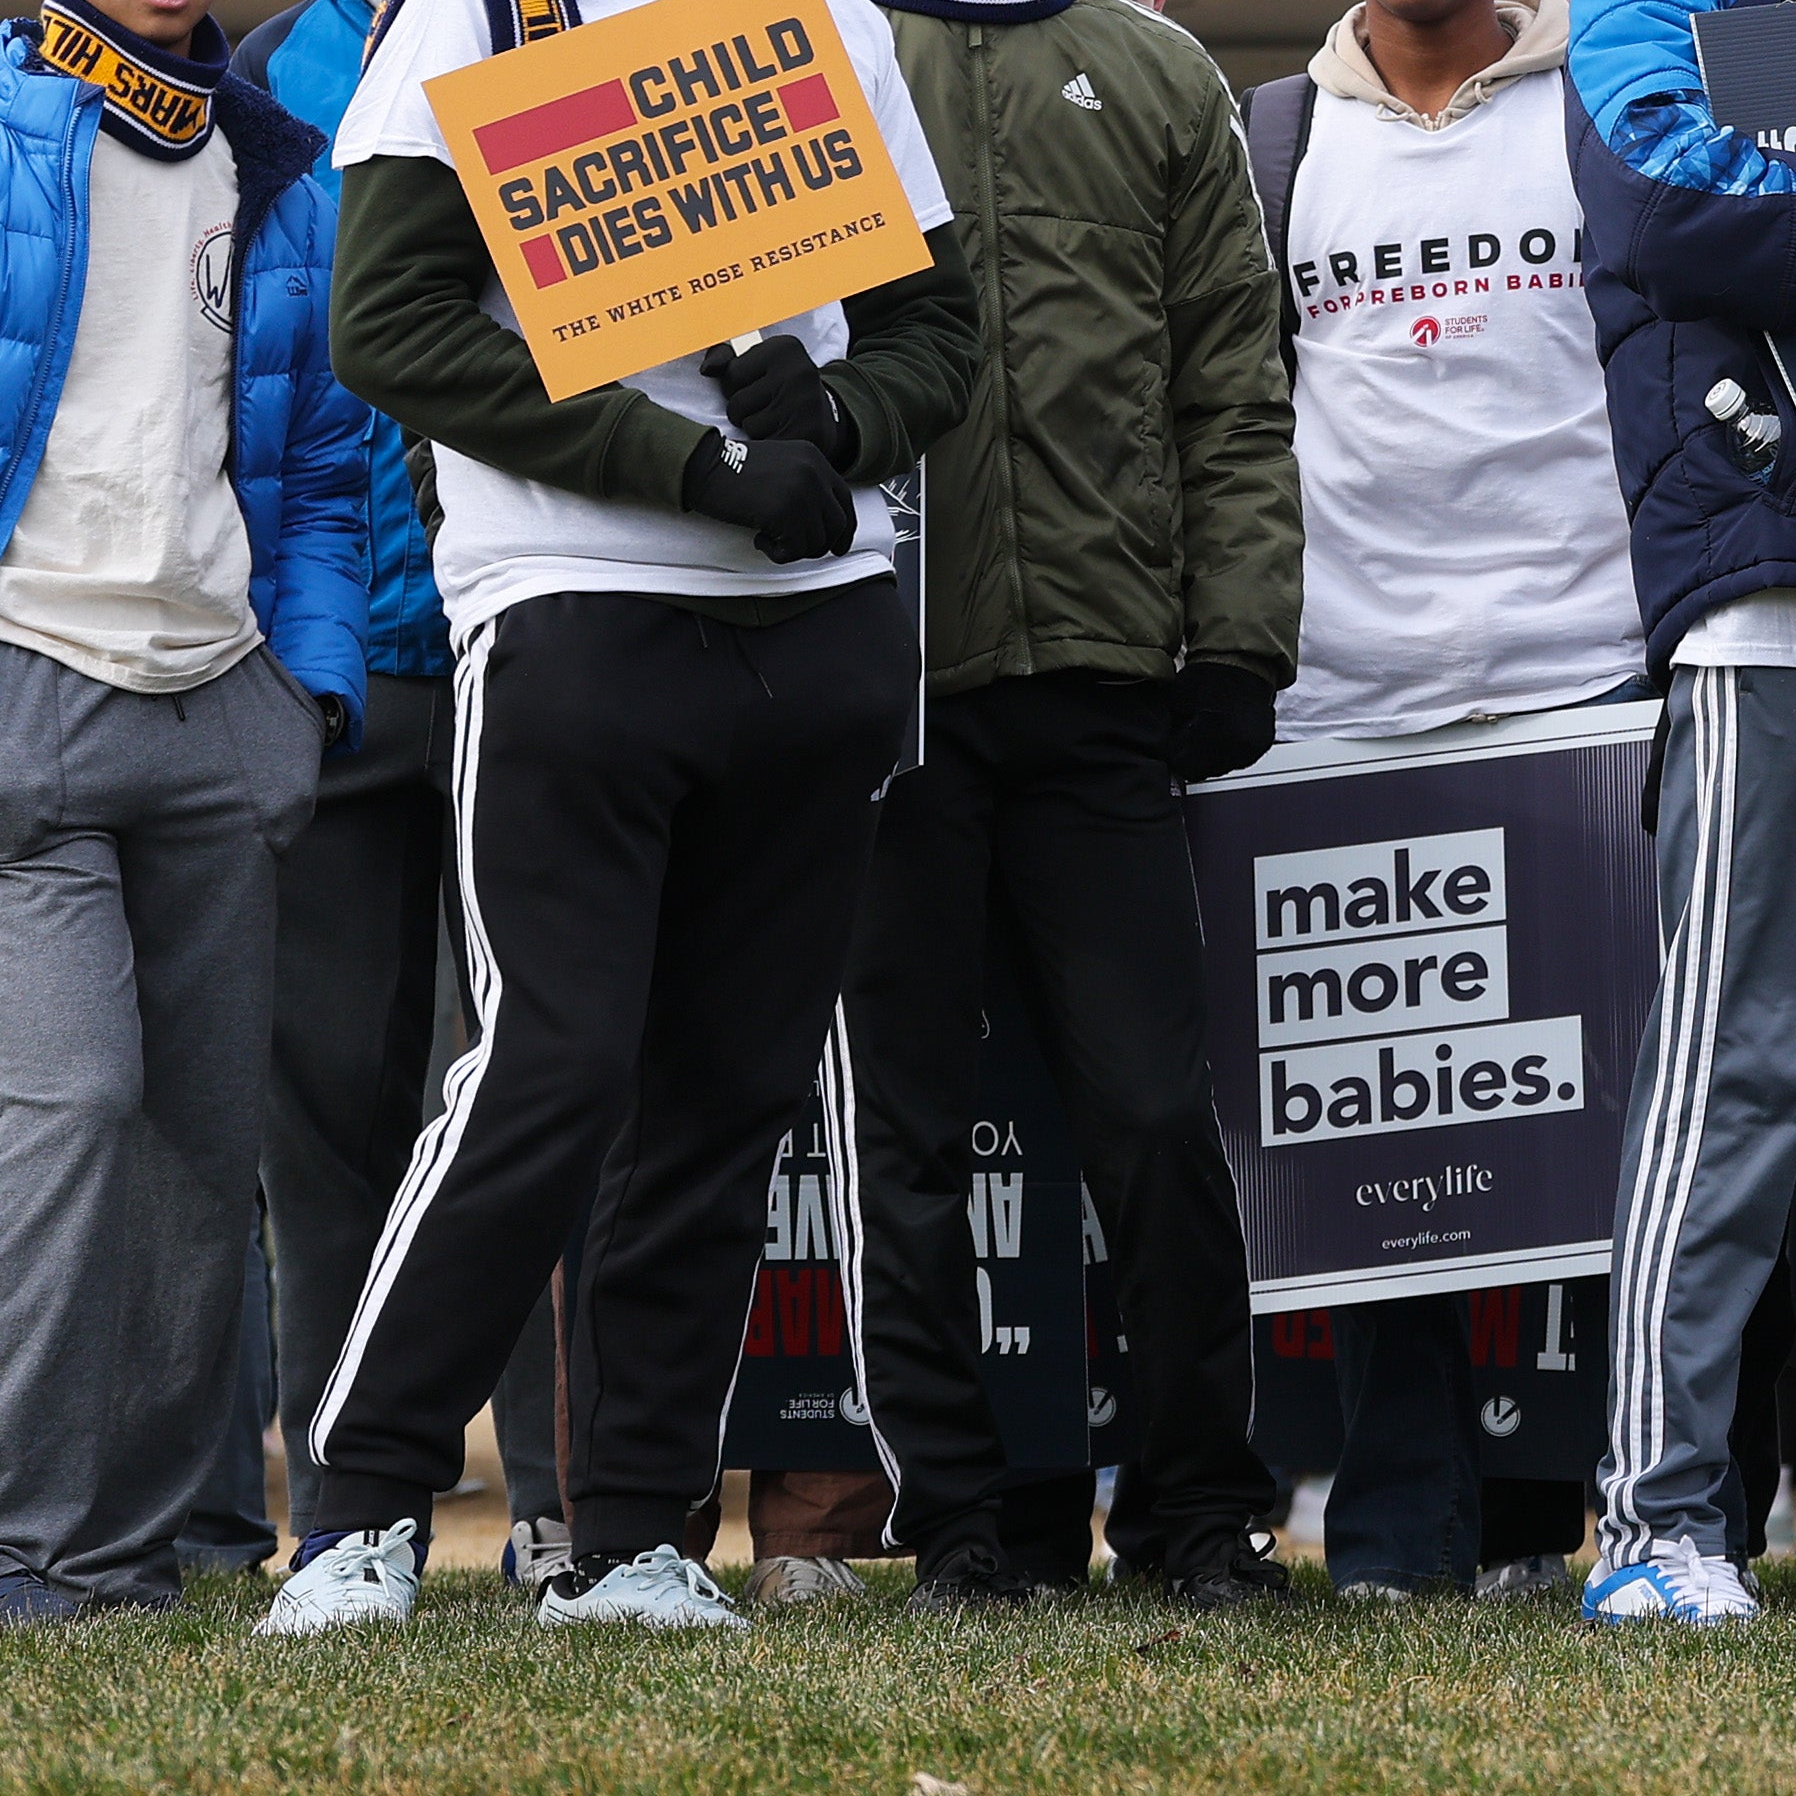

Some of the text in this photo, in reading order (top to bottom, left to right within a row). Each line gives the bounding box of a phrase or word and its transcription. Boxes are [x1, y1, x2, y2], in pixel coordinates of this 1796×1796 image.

[107, 62, 203, 135] MARS
[627, 16, 815, 120] CHILD
[498, 90, 788, 232] SACRIFICE
[555, 127, 864, 278] DIES WITH US
[551, 211, 887, 344] THE WHITE ROSE RESISTANCE
[1293, 226, 1581, 298] FREEDO
[1444, 326, 1463, 335] FOR
[1445, 315, 1488, 326] STUDENTS
[1266, 847, 1493, 939] make
[1267, 950, 1490, 1025] more
[1270, 1043, 1577, 1137] babies.
[971, 1120, 1023, 1157] YO
[1355, 1163, 1495, 1212] everylife
[1381, 1228, 1472, 1252] everylife.com
[779, 1409, 835, 1420] STUDENTS
[811, 1399, 835, 1409] FOR
